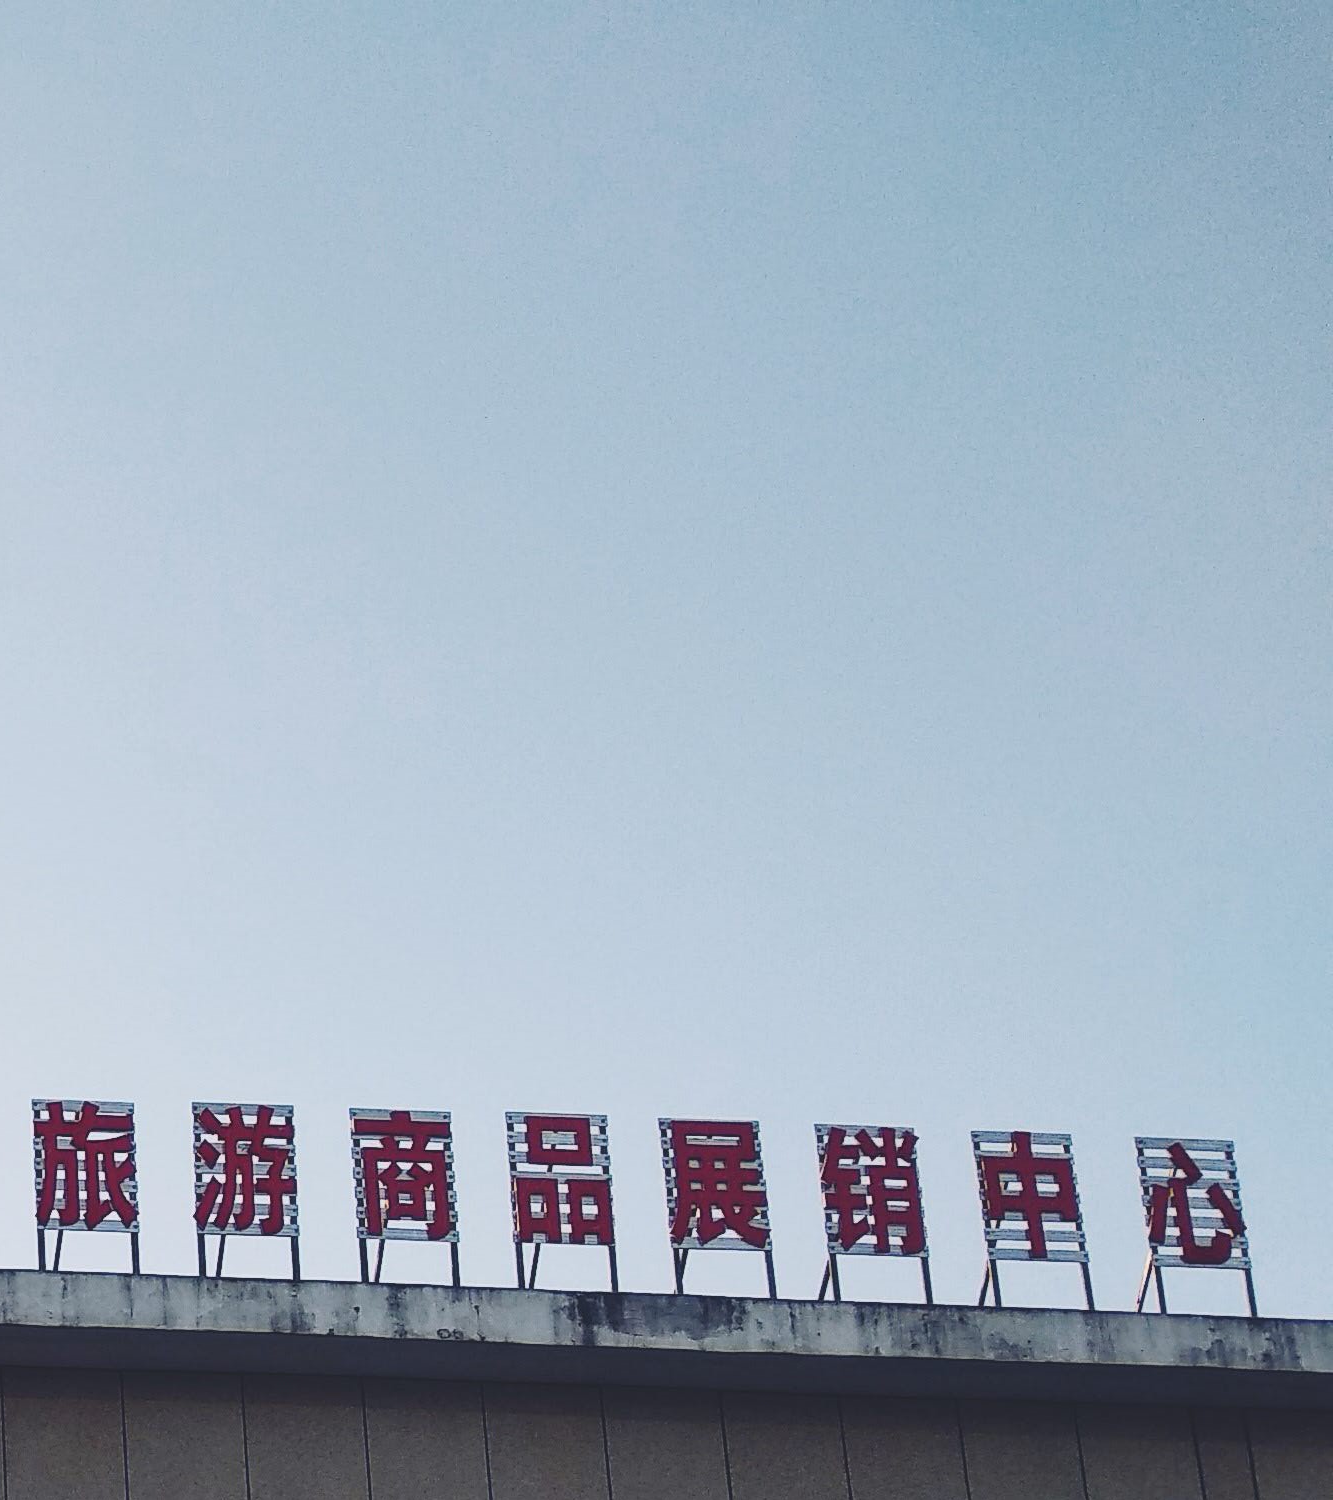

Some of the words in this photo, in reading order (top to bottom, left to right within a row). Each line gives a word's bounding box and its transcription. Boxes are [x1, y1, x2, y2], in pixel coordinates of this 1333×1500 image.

[32, 1098, 1241, 1266] 旅游商品展销中心
